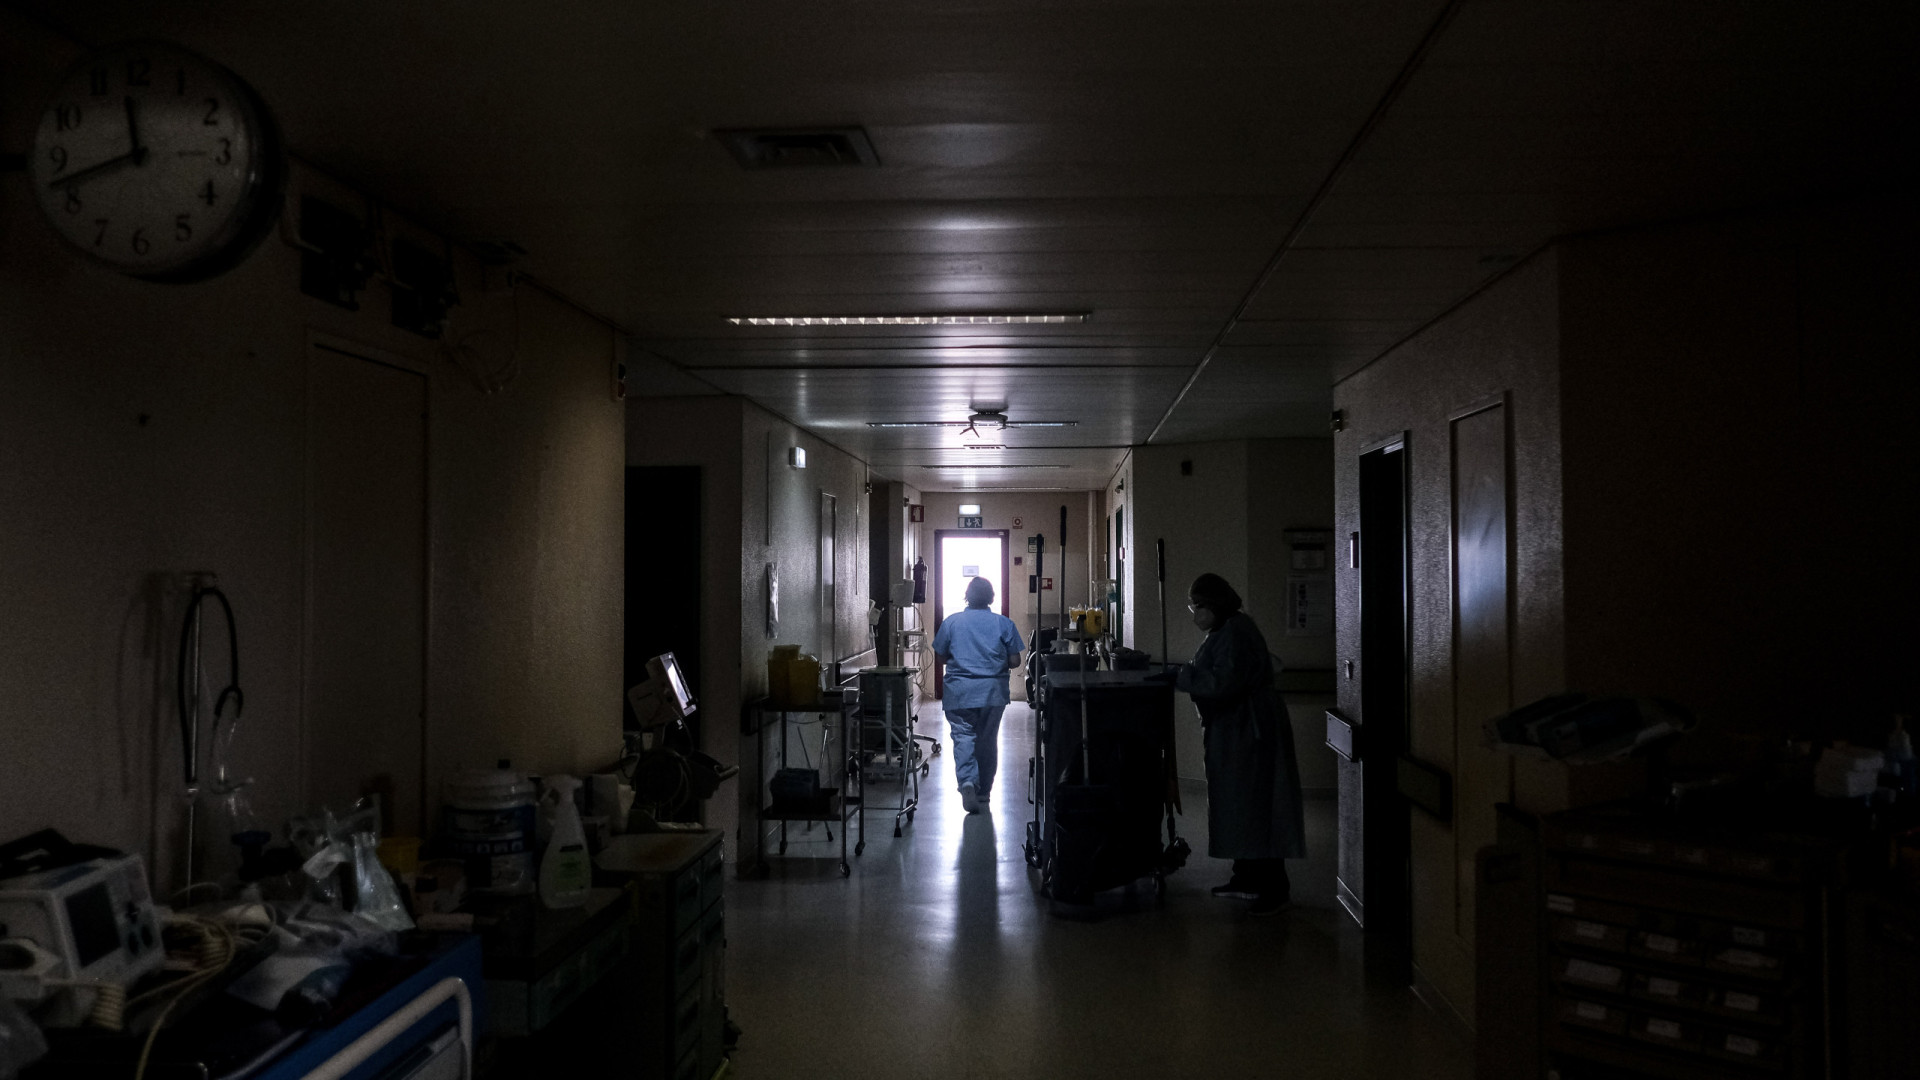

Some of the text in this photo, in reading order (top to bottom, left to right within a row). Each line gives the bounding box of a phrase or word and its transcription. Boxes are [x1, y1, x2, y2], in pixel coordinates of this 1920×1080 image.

[90, 67, 107, 95] 11
[126, 58, 149, 85] 12
[176, 68, 185, 95] 1
[56, 104, 81, 132] 10
[204, 98, 218, 125] 2
[50, 145, 67, 173] 9
[215, 138, 231, 165] 3
[65, 181, 81, 214] 8
[198, 181, 218, 205] 4
[95, 219, 108, 247] 7
[176, 214, 192, 241] 5
[132, 229, 150, 256] 6
